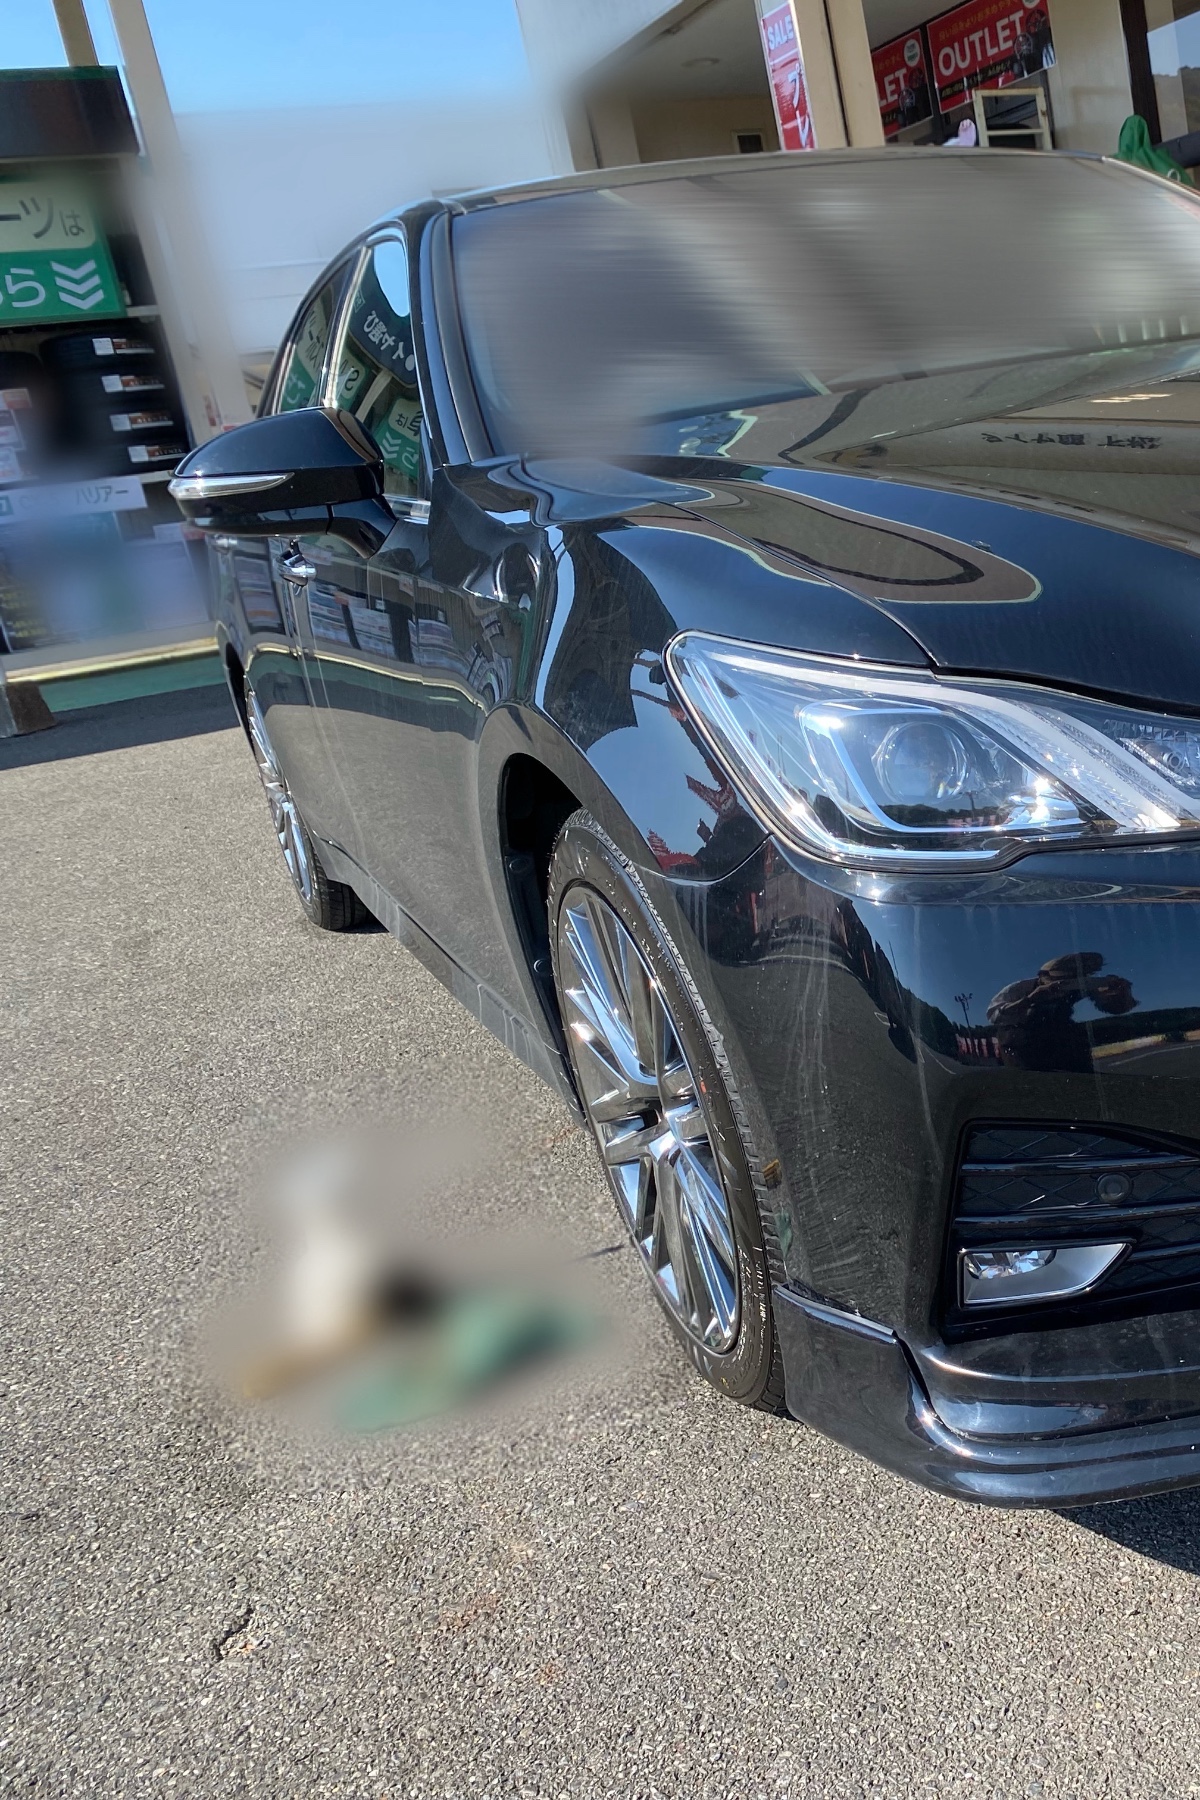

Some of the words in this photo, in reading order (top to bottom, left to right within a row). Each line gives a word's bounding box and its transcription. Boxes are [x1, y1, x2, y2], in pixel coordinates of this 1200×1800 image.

[767, 14, 794, 50] SALE
[938, 9, 1024, 77] OUTLET
[0, 267, 46, 308] ら
